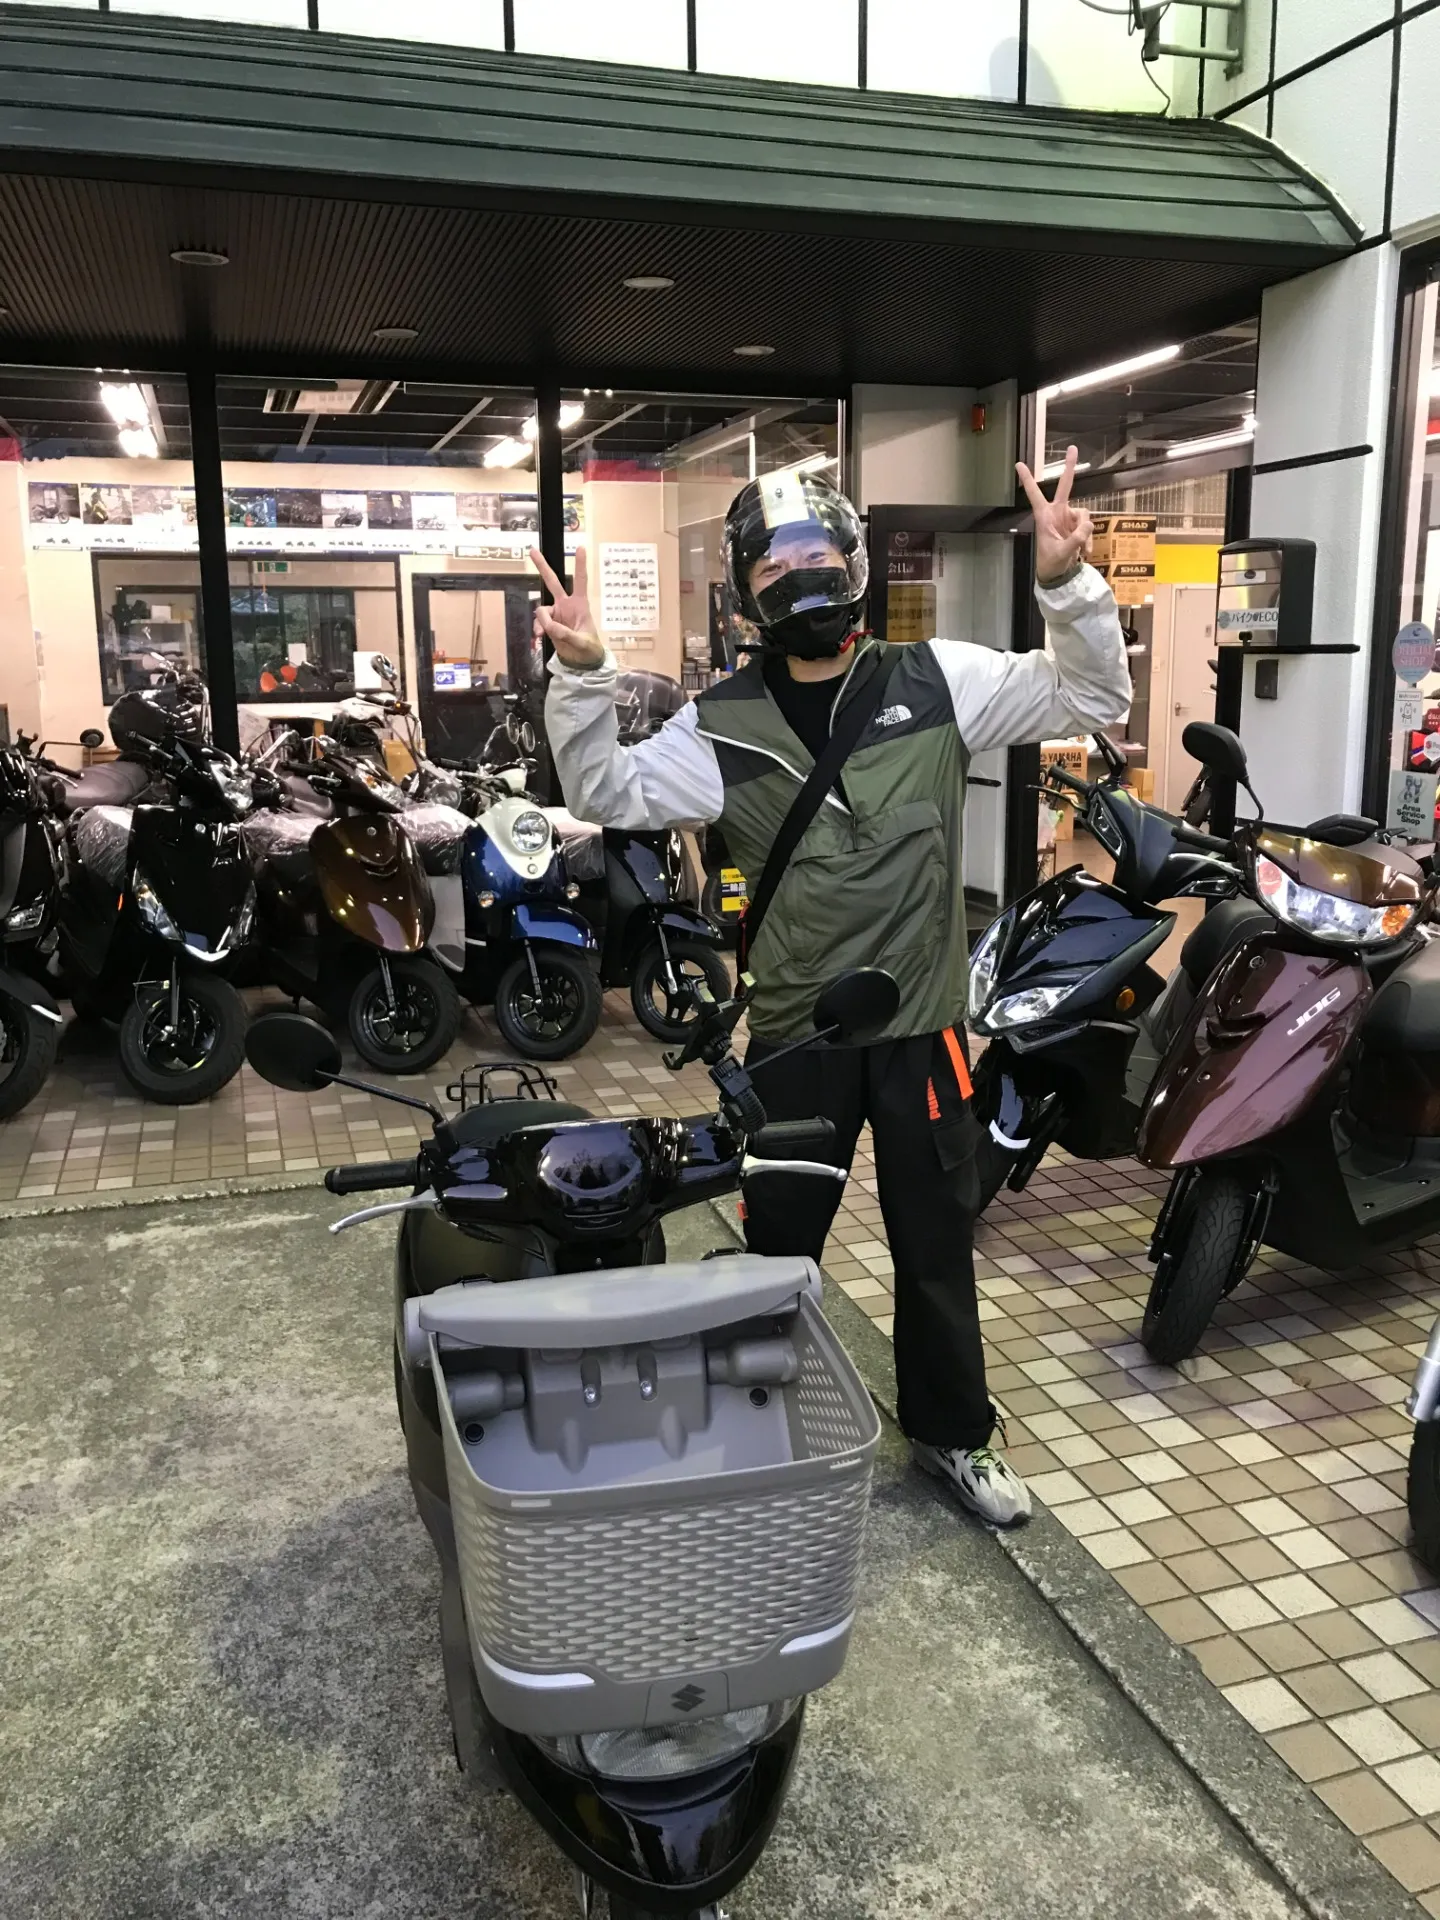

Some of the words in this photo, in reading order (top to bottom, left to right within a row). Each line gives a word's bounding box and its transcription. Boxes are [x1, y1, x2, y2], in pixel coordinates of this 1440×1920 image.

[1401, 656, 1426, 667] SHOP
[883, 706, 898, 716] THE
[875, 711, 900, 724] NORTH
[884, 717, 901, 727] FACE
[1048, 752, 1082, 762] YAMAHA
[1402, 803, 1421, 813] Area
[1396, 808, 1426, 820] Service
[1401, 814, 1421, 826] Shop
[1286, 986, 1341, 1036] JOG
